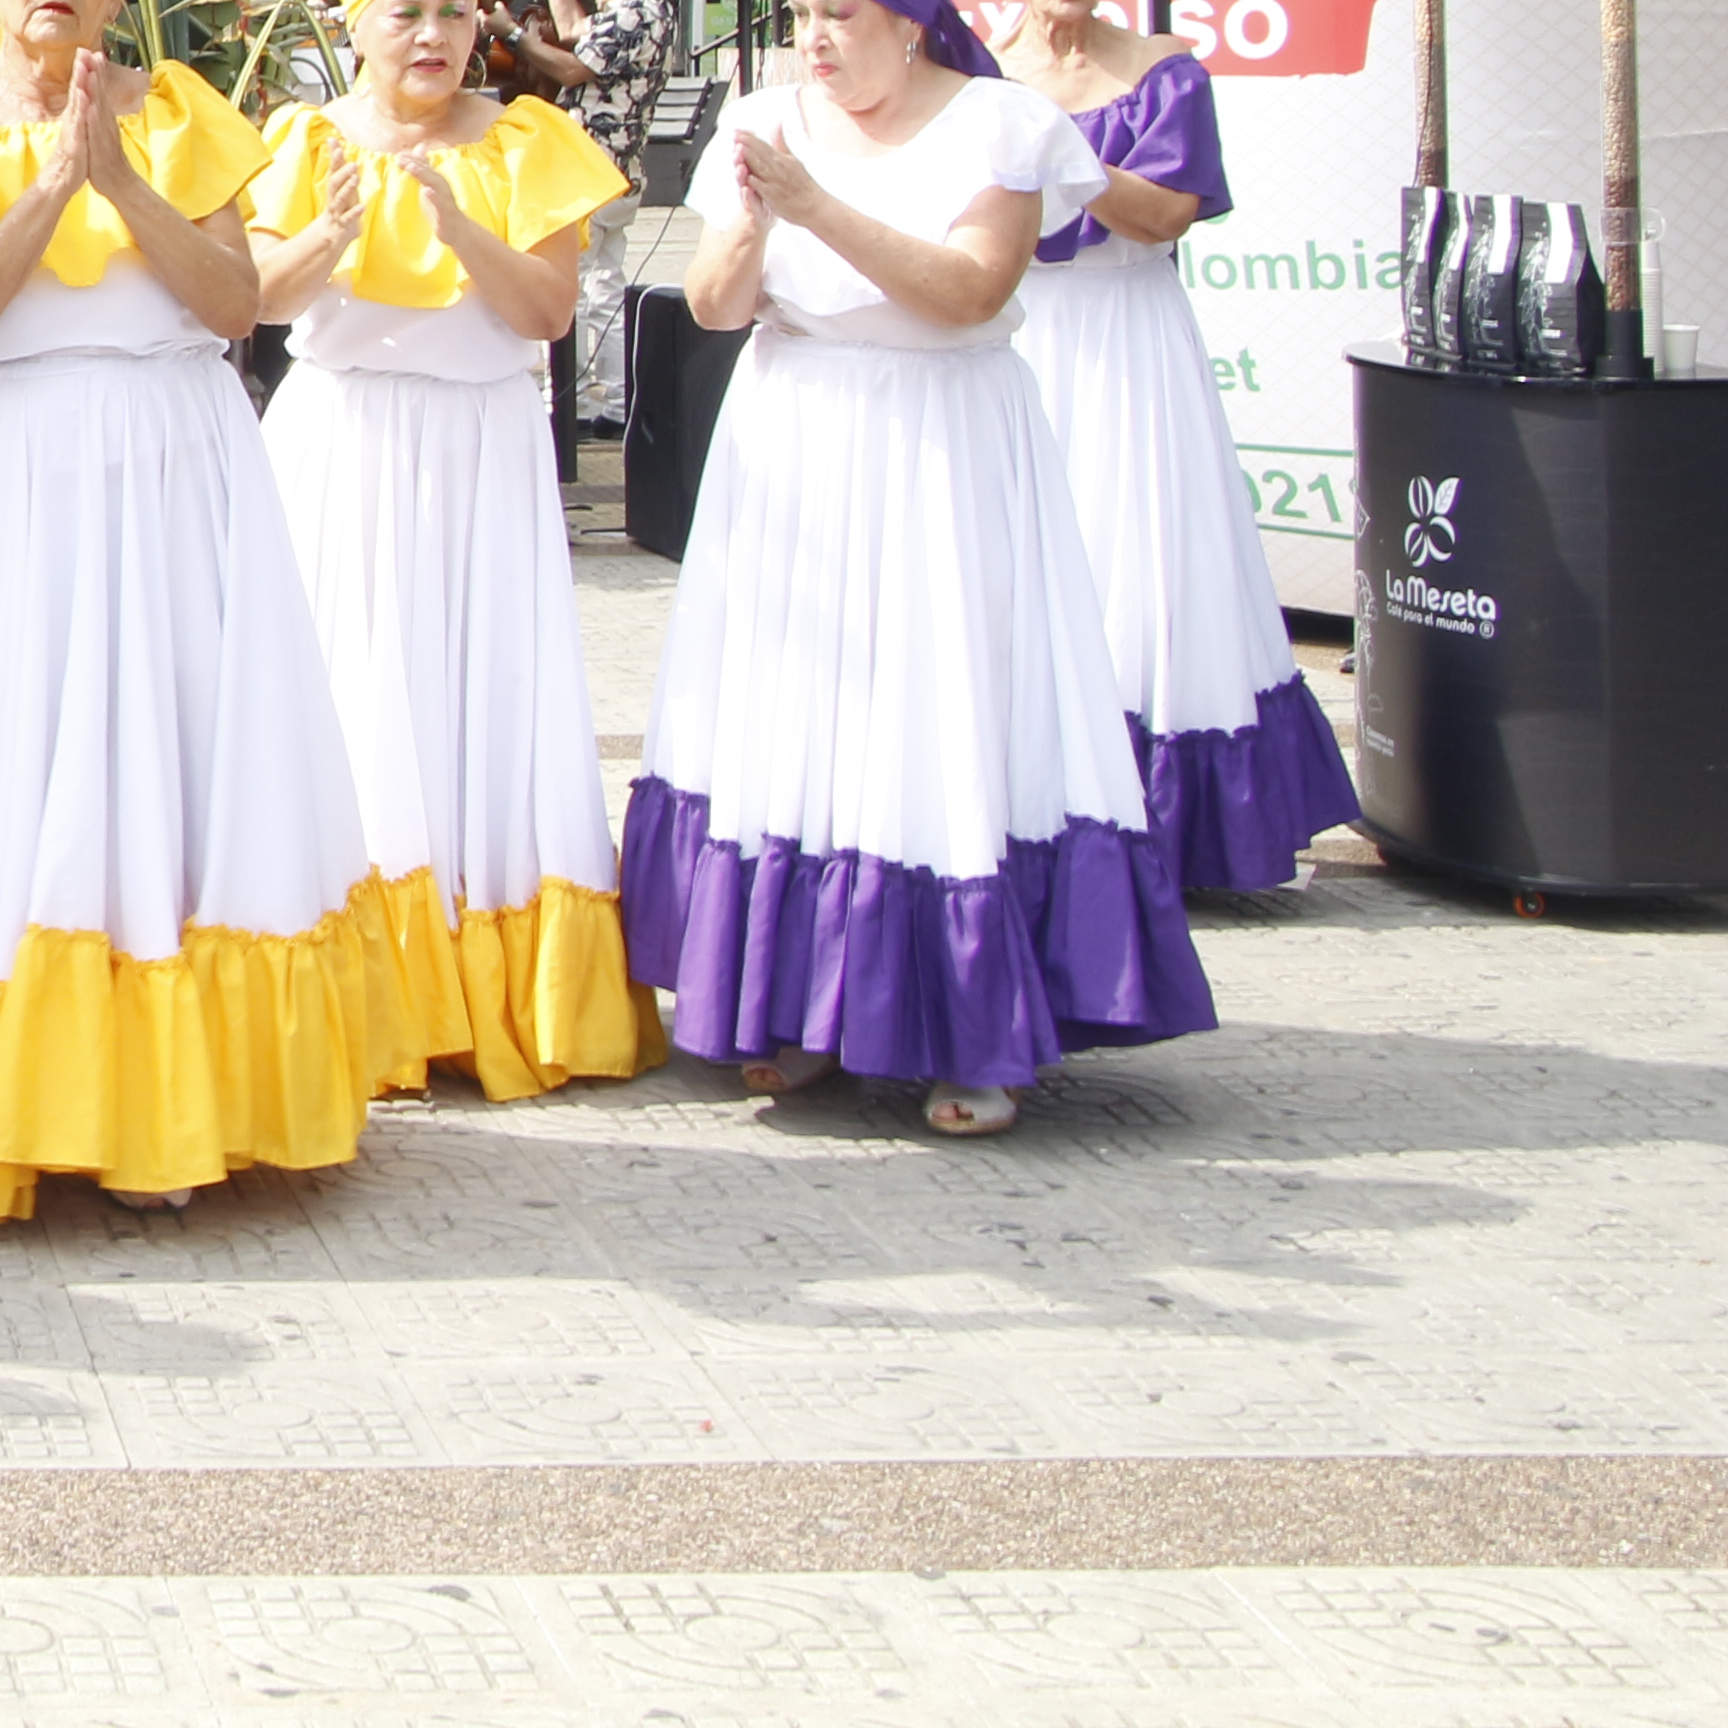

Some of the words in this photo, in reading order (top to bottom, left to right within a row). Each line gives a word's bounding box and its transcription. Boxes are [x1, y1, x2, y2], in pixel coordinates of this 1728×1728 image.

[1386, 569, 1404, 602] La
[1406, 574, 1497, 621] Meseta
[1403, 608, 1423, 623] para
[1425, 612, 1434, 626] el
[1436, 616, 1476, 635] mundo
